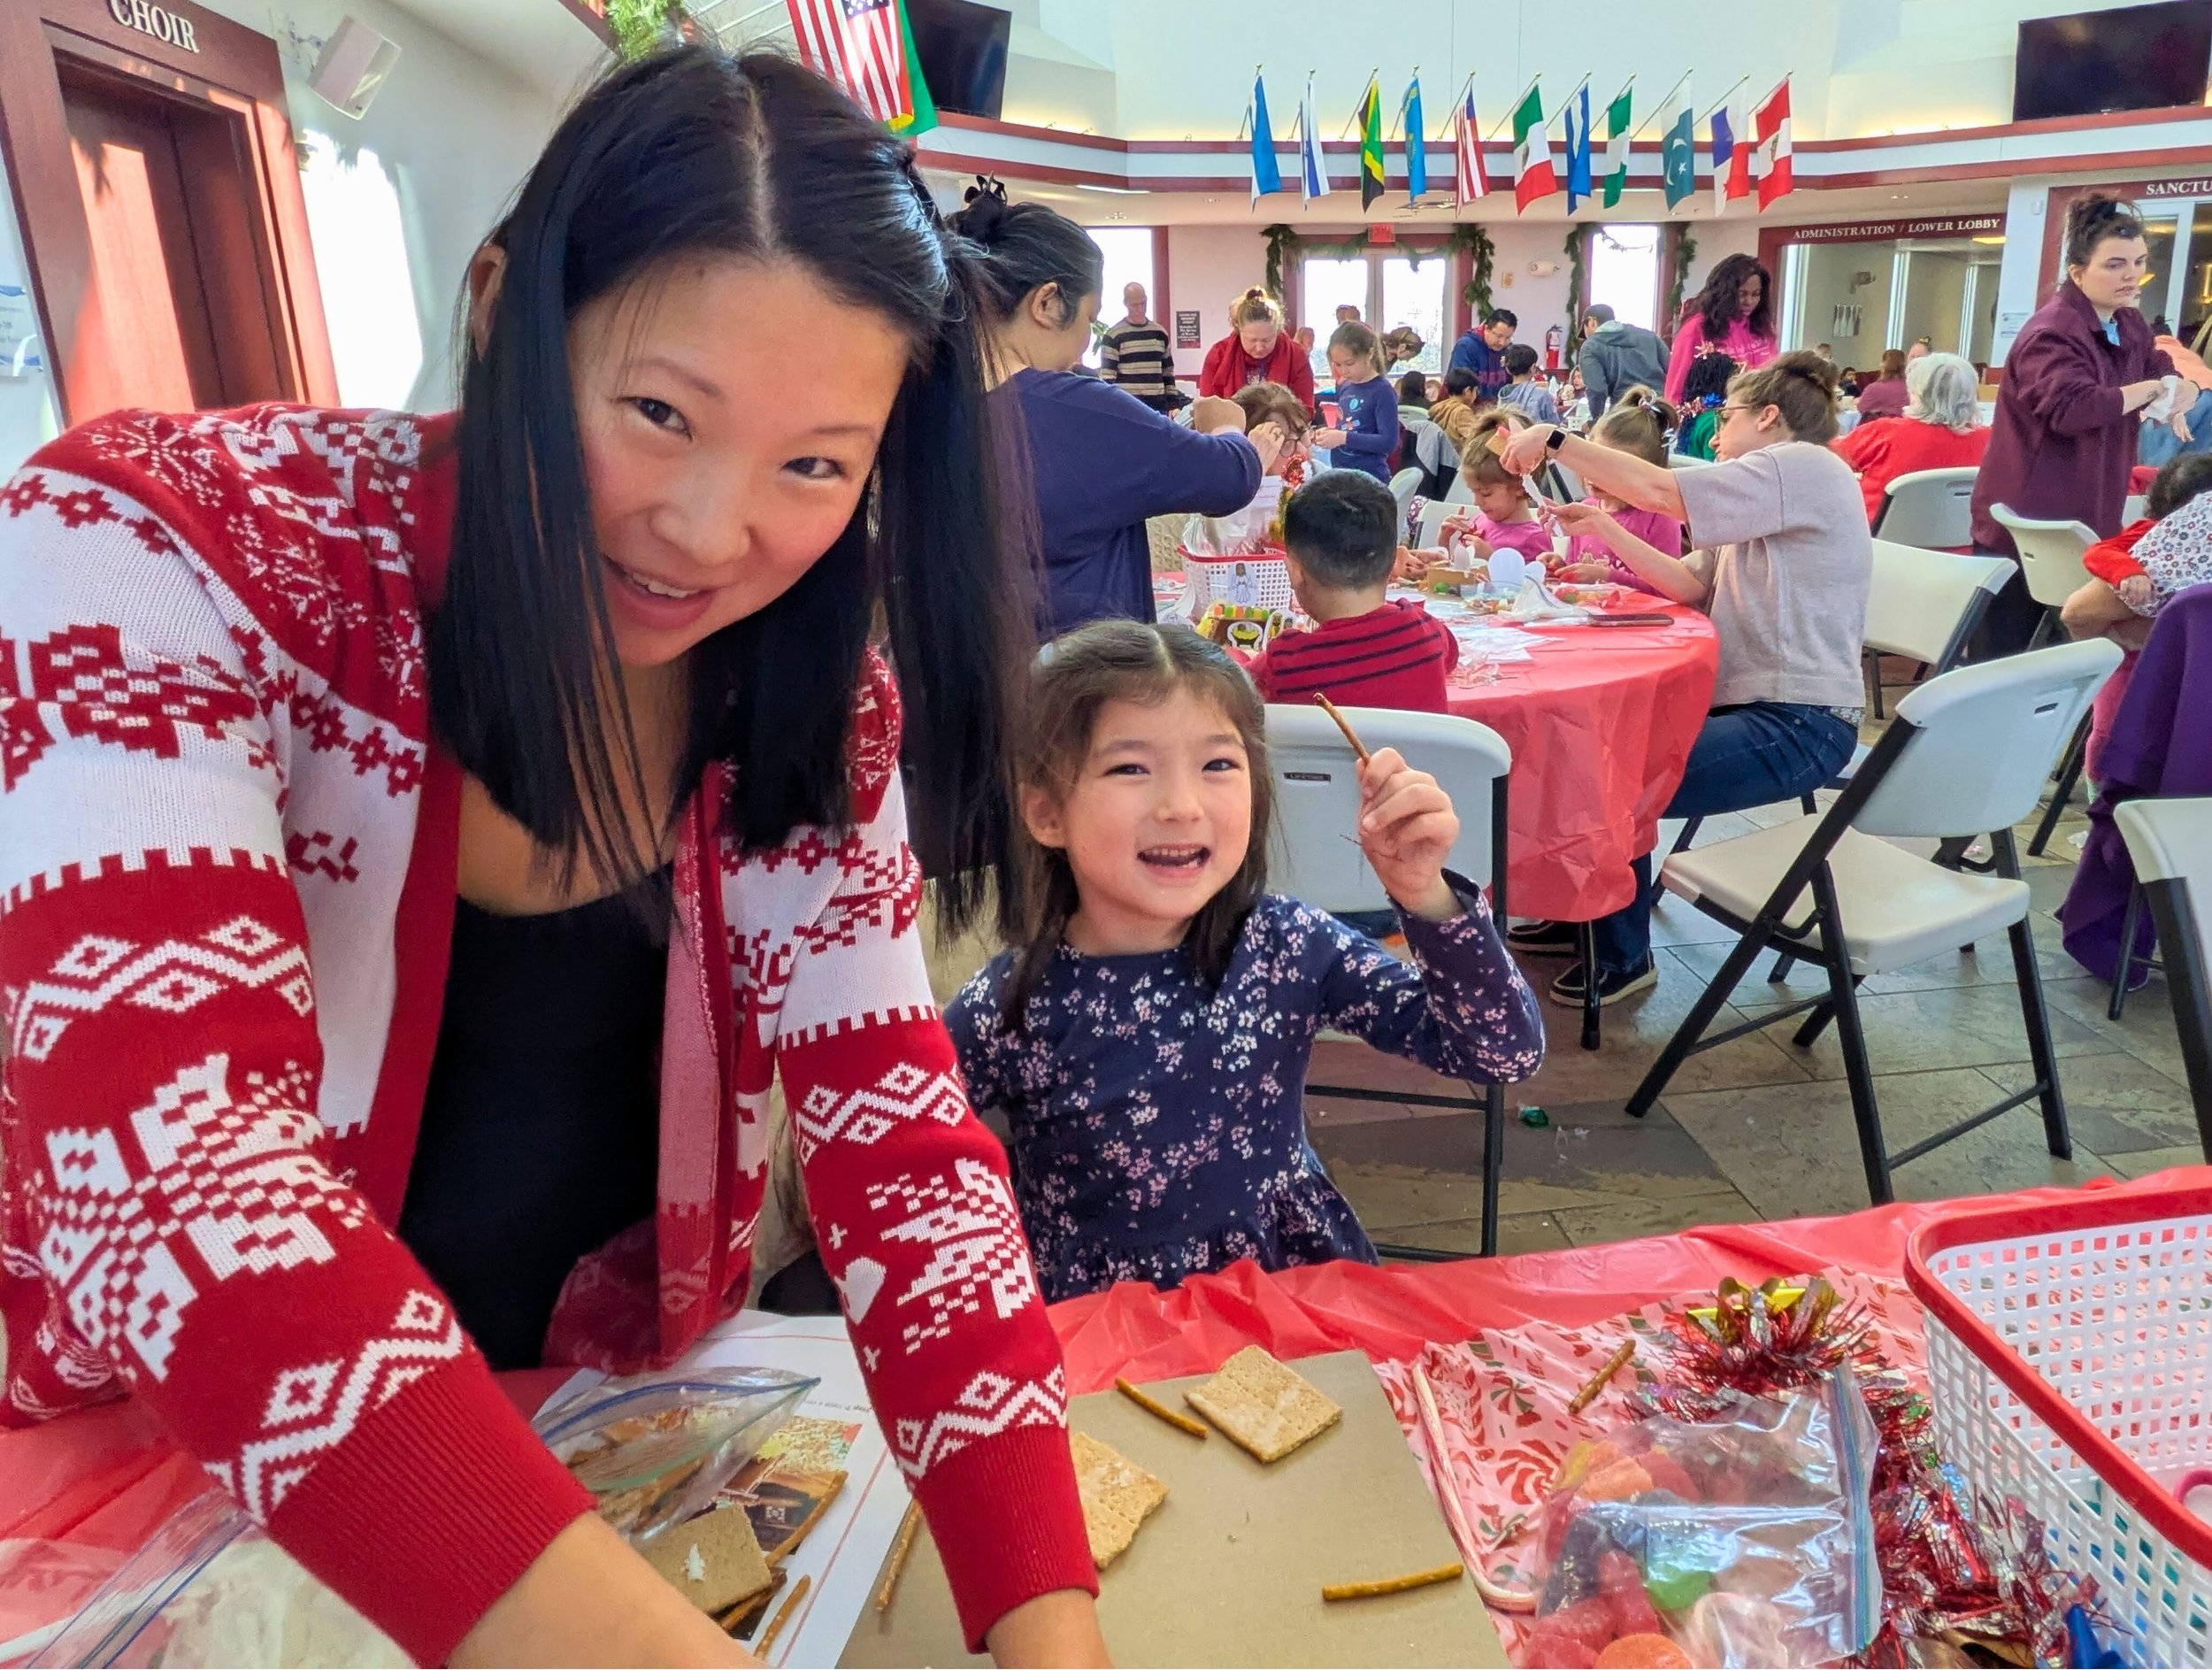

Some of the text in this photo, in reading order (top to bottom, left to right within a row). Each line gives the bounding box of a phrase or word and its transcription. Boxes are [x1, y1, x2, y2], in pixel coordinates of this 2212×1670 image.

[109, 0, 200, 53] CHOIR
[2146, 180, 2212, 196] SANCTU
[1793, 225, 1895, 239] ADMINISTRATION
[1908, 221, 1954, 233] LOWER
[1956, 219, 2001, 230] LOBBY
